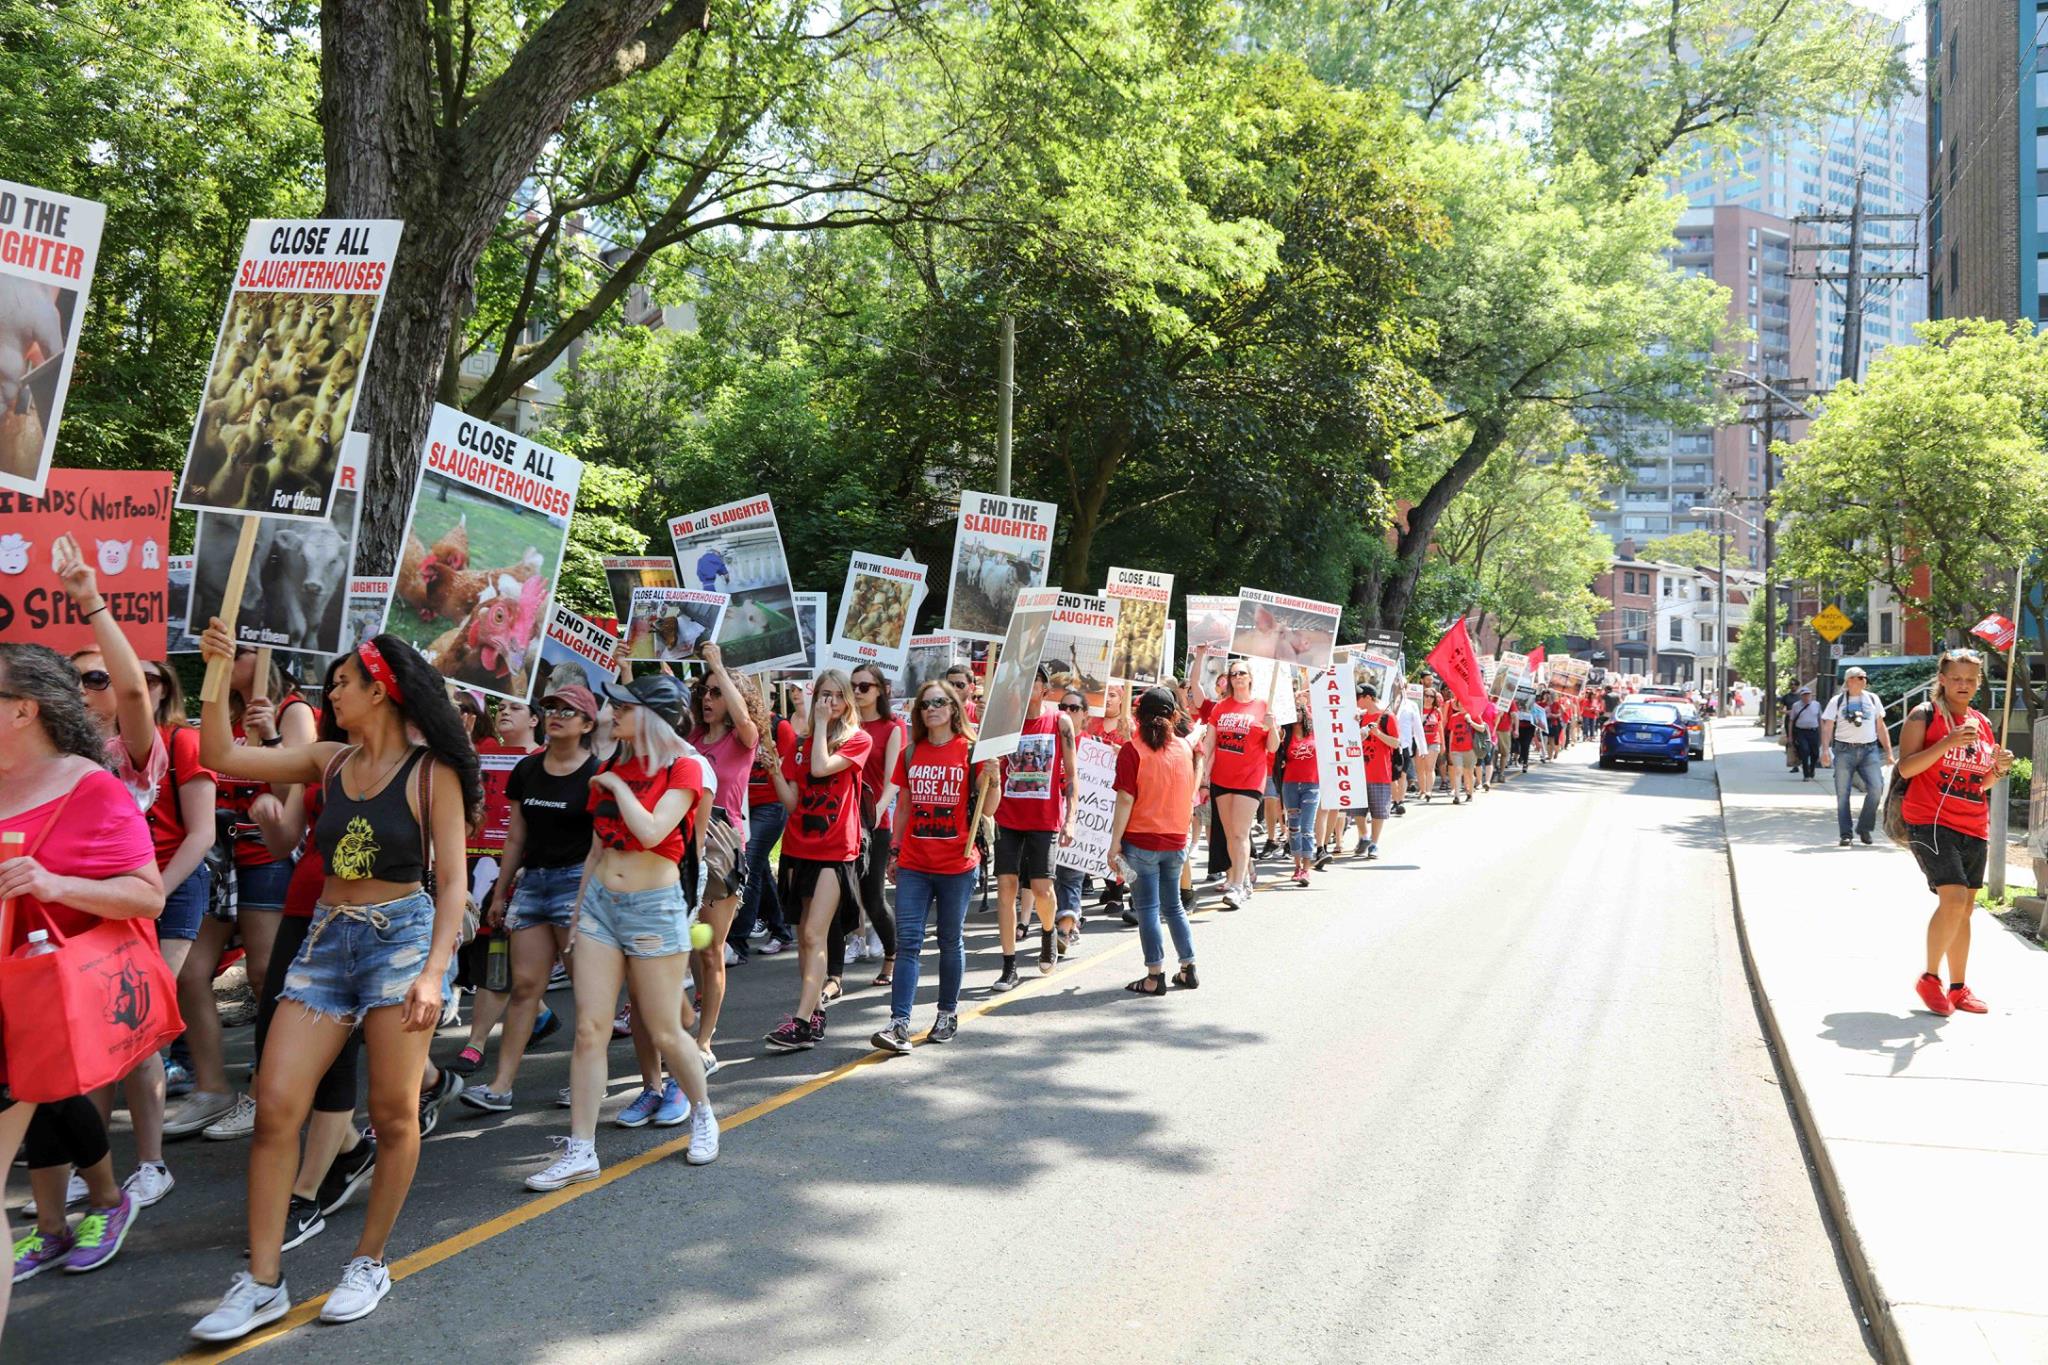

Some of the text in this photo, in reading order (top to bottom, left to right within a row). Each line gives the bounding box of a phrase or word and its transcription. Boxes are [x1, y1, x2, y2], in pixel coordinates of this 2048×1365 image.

[23, 197, 70, 238] THE
[269, 226, 371, 256] CLOSE ALL
[239, 260, 386, 291] SLAUGHTERHOUSES
[457, 421, 555, 481] CLOSE ALL
[428, 441, 571, 517] SLAUGHTERHOUSES
[271, 488, 322, 511] For them
[979, 498, 1038, 522] END THE
[672, 500, 771, 537] END all SLAUGHTER
[963, 513, 1048, 542] SLAUGHTER
[854, 560, 923, 582] END THE SLAUGHTER
[1118, 571, 1161, 588] CLOSE ALL
[634, 590, 727, 605] CLOSE ALL SLAUGHTERHOUSES
[1107, 582, 1169, 601] SLAUGHTERHOUSES
[1241, 590, 1262, 600] CLOSE
[1262, 593, 1275, 603] ALL
[1274, 595, 1340, 616] SLAUGHTERHOUSES
[1056, 594, 1107, 613] END THE
[555, 609, 613, 652] END THE
[1051, 610, 1115, 629] LAUGHTER
[239, 625, 290, 645] For them
[546, 622, 618, 673] LAUGHTER
[832, 651, 872, 666] Unsuspected
[858, 645, 878, 658] EGGS
[908, 765, 964, 783] MARCH TO
[941, 781, 961, 796] ALL
